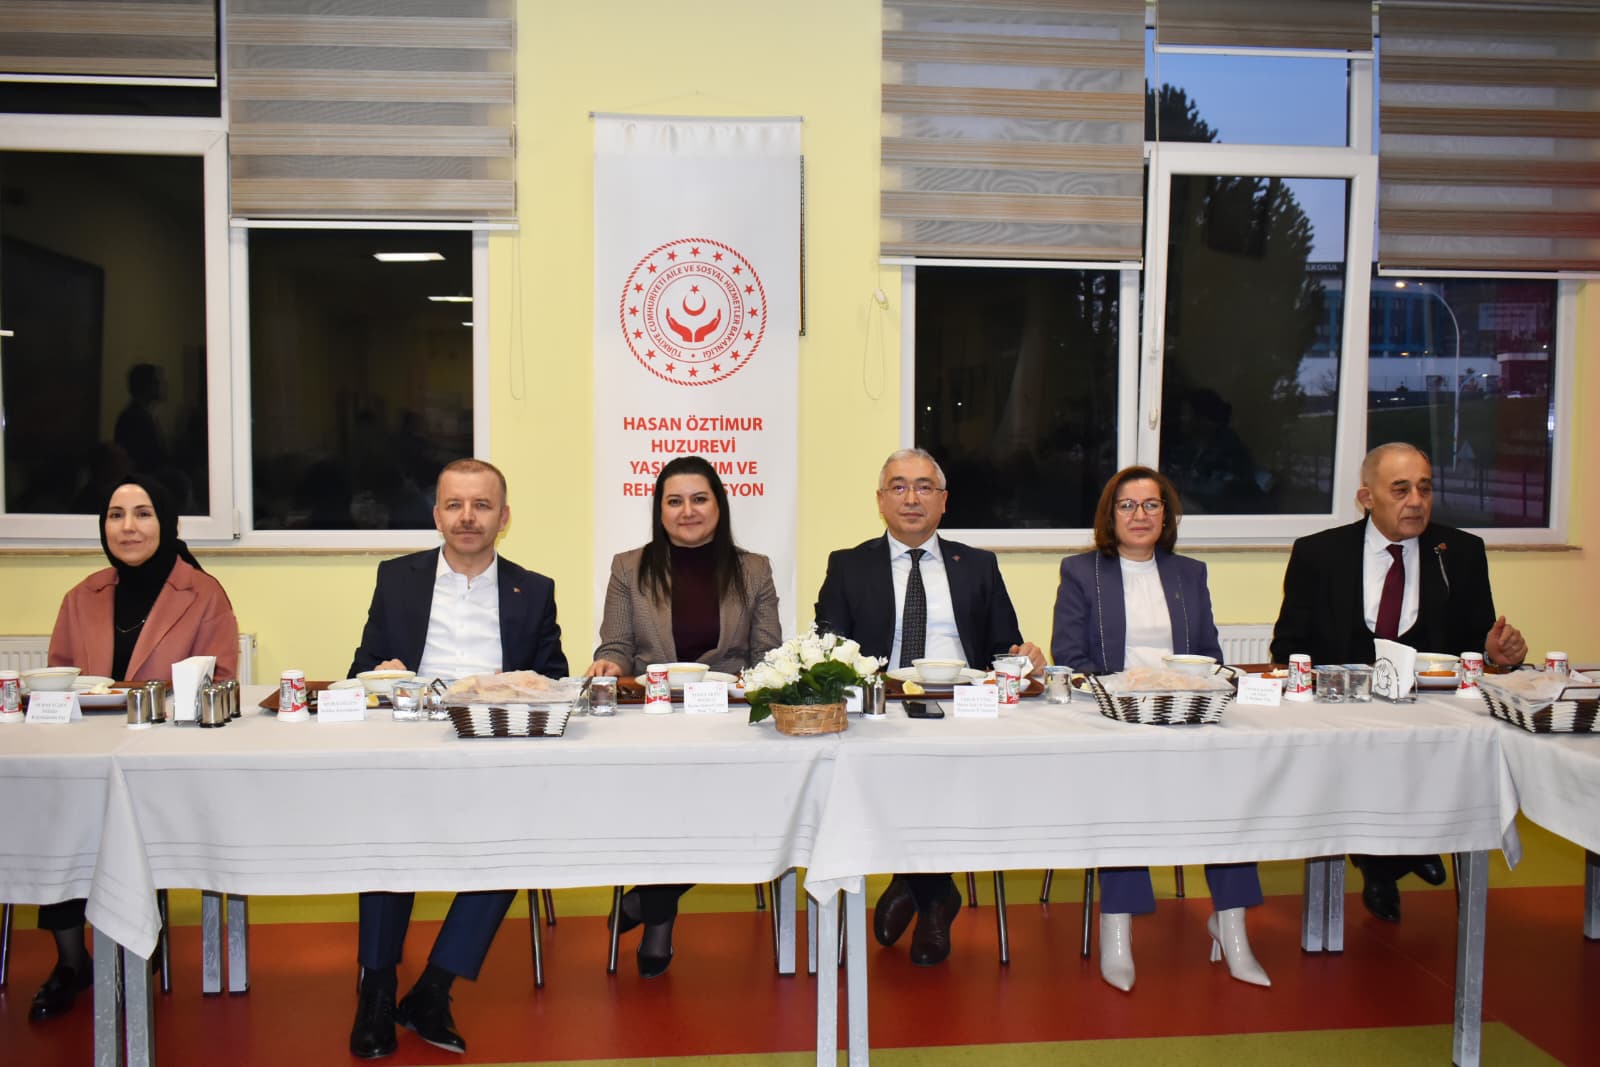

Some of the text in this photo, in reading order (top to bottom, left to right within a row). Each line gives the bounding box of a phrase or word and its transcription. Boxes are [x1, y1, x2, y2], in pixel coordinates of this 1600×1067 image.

[696, 265, 725, 283] SOSYAL
[623, 415, 764, 432] HASAN ÖZTİMUR
[651, 437, 736, 453] HUZUREVİ
[630, 461, 665, 478] YAŞ
[736, 461, 758, 475] VE
